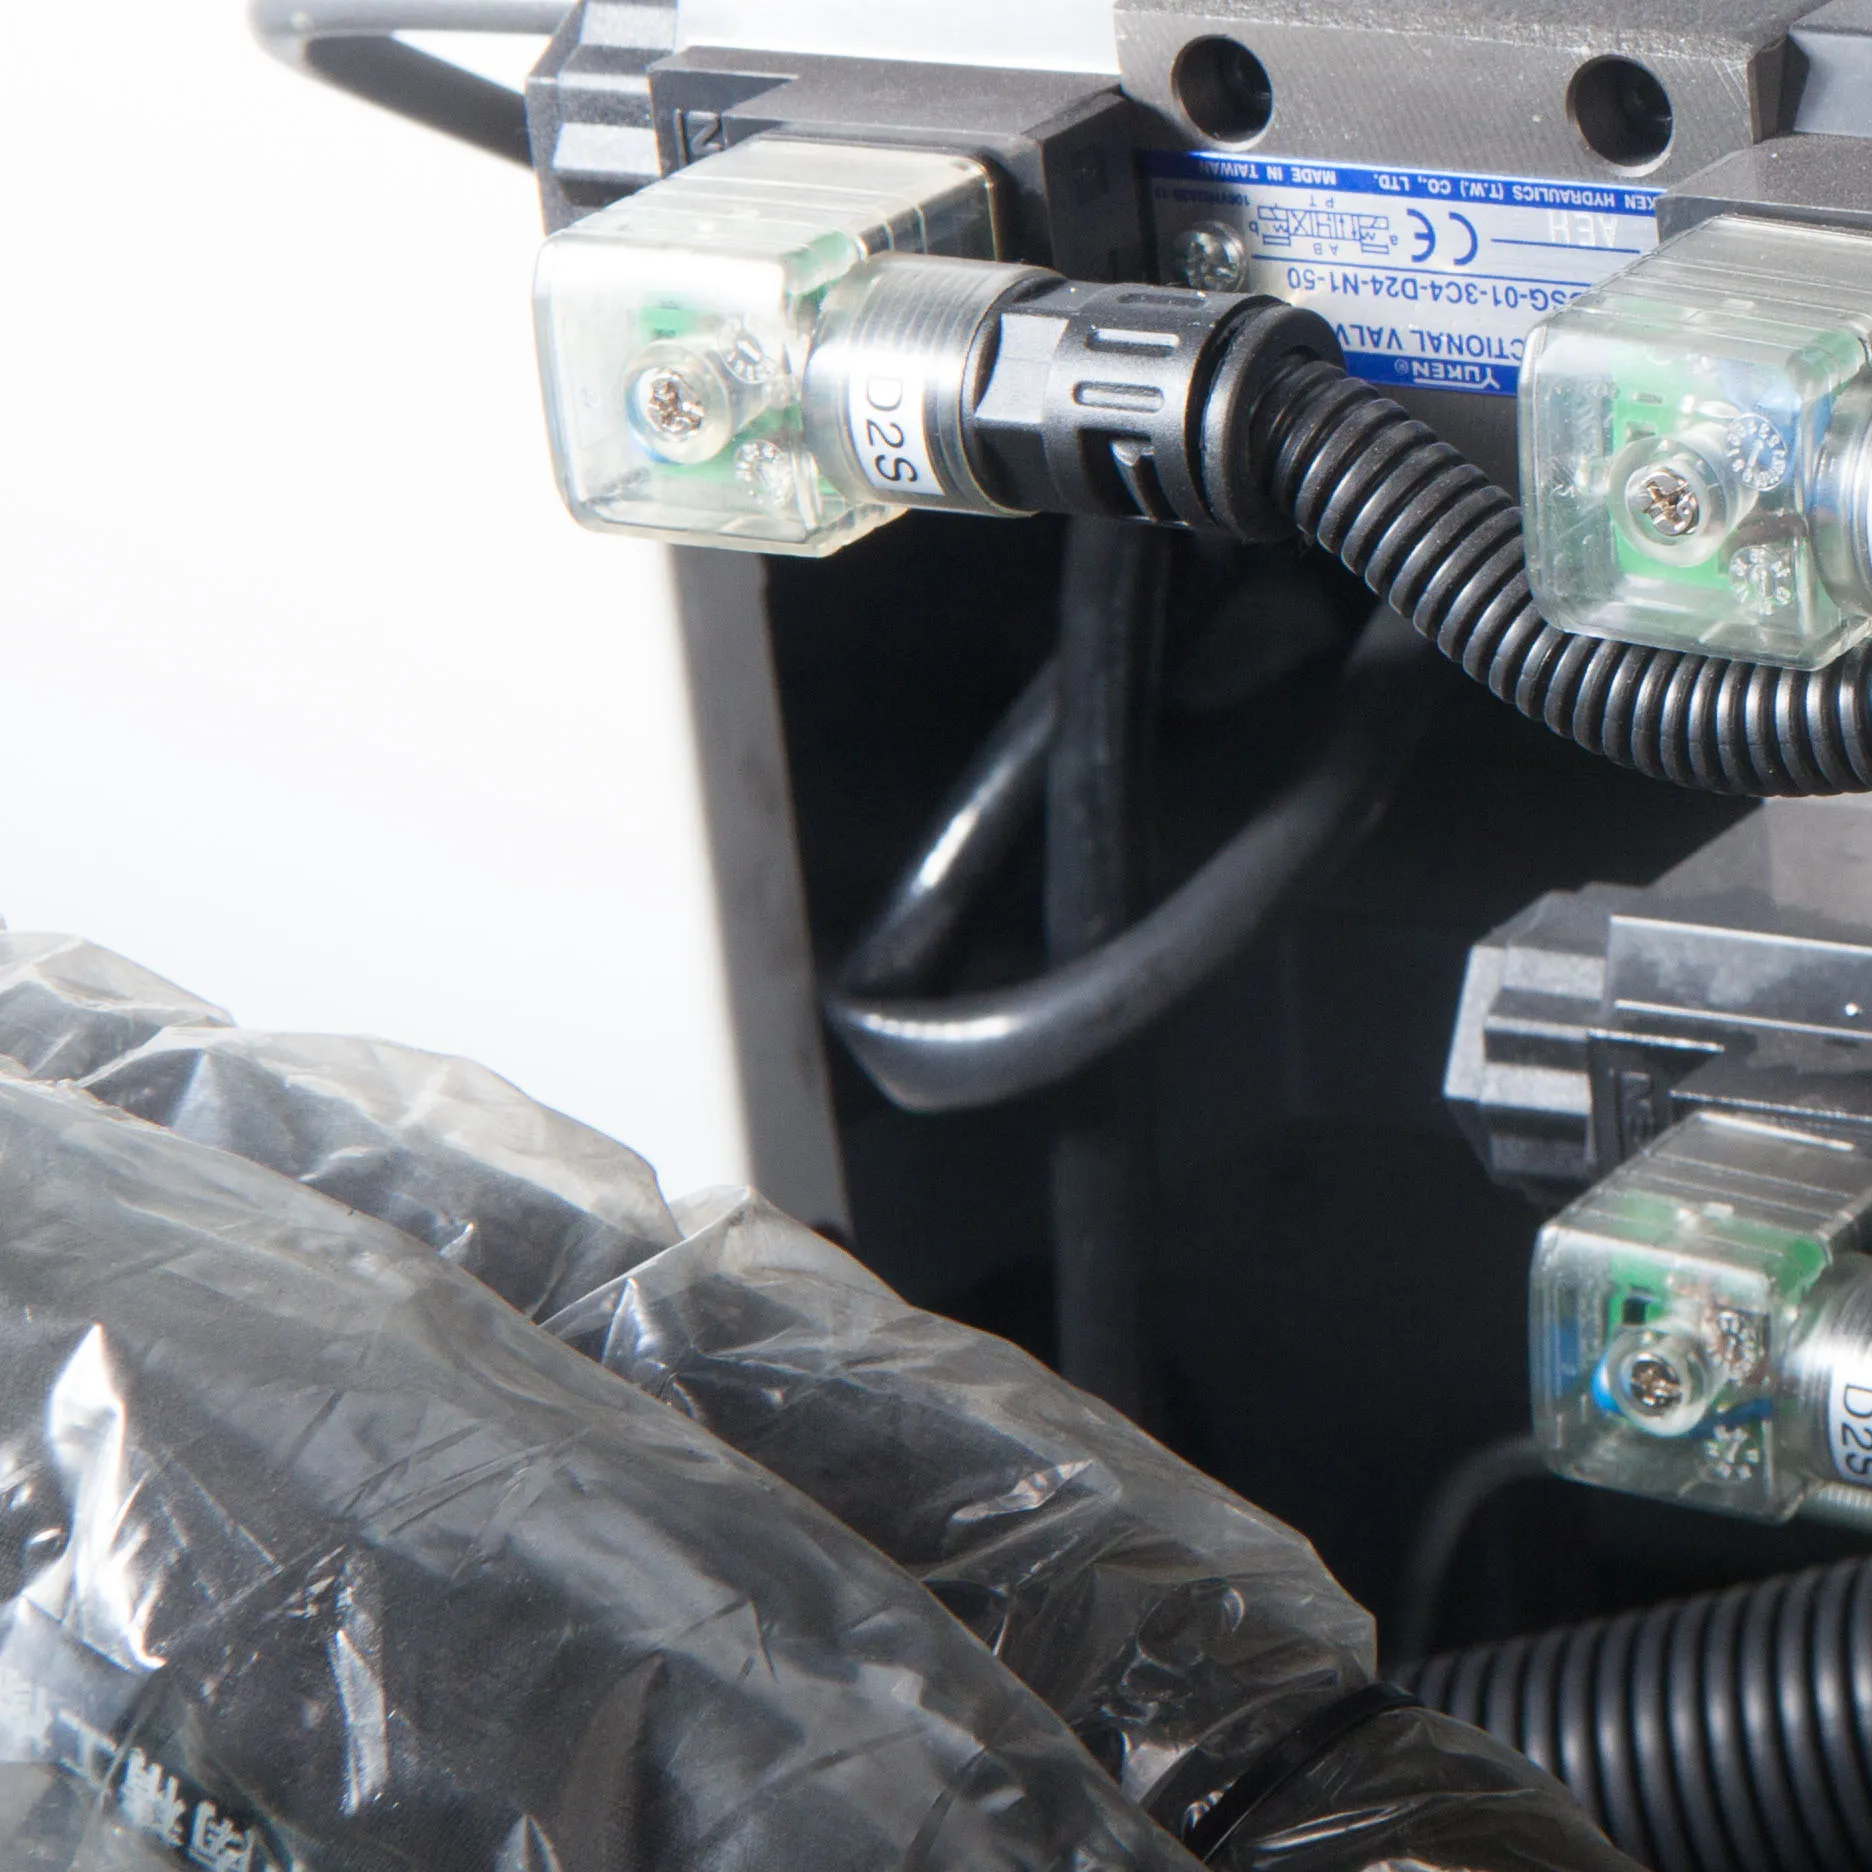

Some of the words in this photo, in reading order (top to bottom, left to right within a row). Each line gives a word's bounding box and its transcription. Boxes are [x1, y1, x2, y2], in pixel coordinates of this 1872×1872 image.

[1198, 159, 1259, 179] TAIWAN
[1266, 165, 1283, 181] IN
[1289, 167, 1336, 186] MADE
[1513, 183, 1615, 208] HYDRAULICS
[1624, 192, 1657, 211] KEN
[1335, 325, 1401, 351] VALV
[1410, 329, 1526, 361] CTIONAL
[862, 376, 924, 485] D2S
